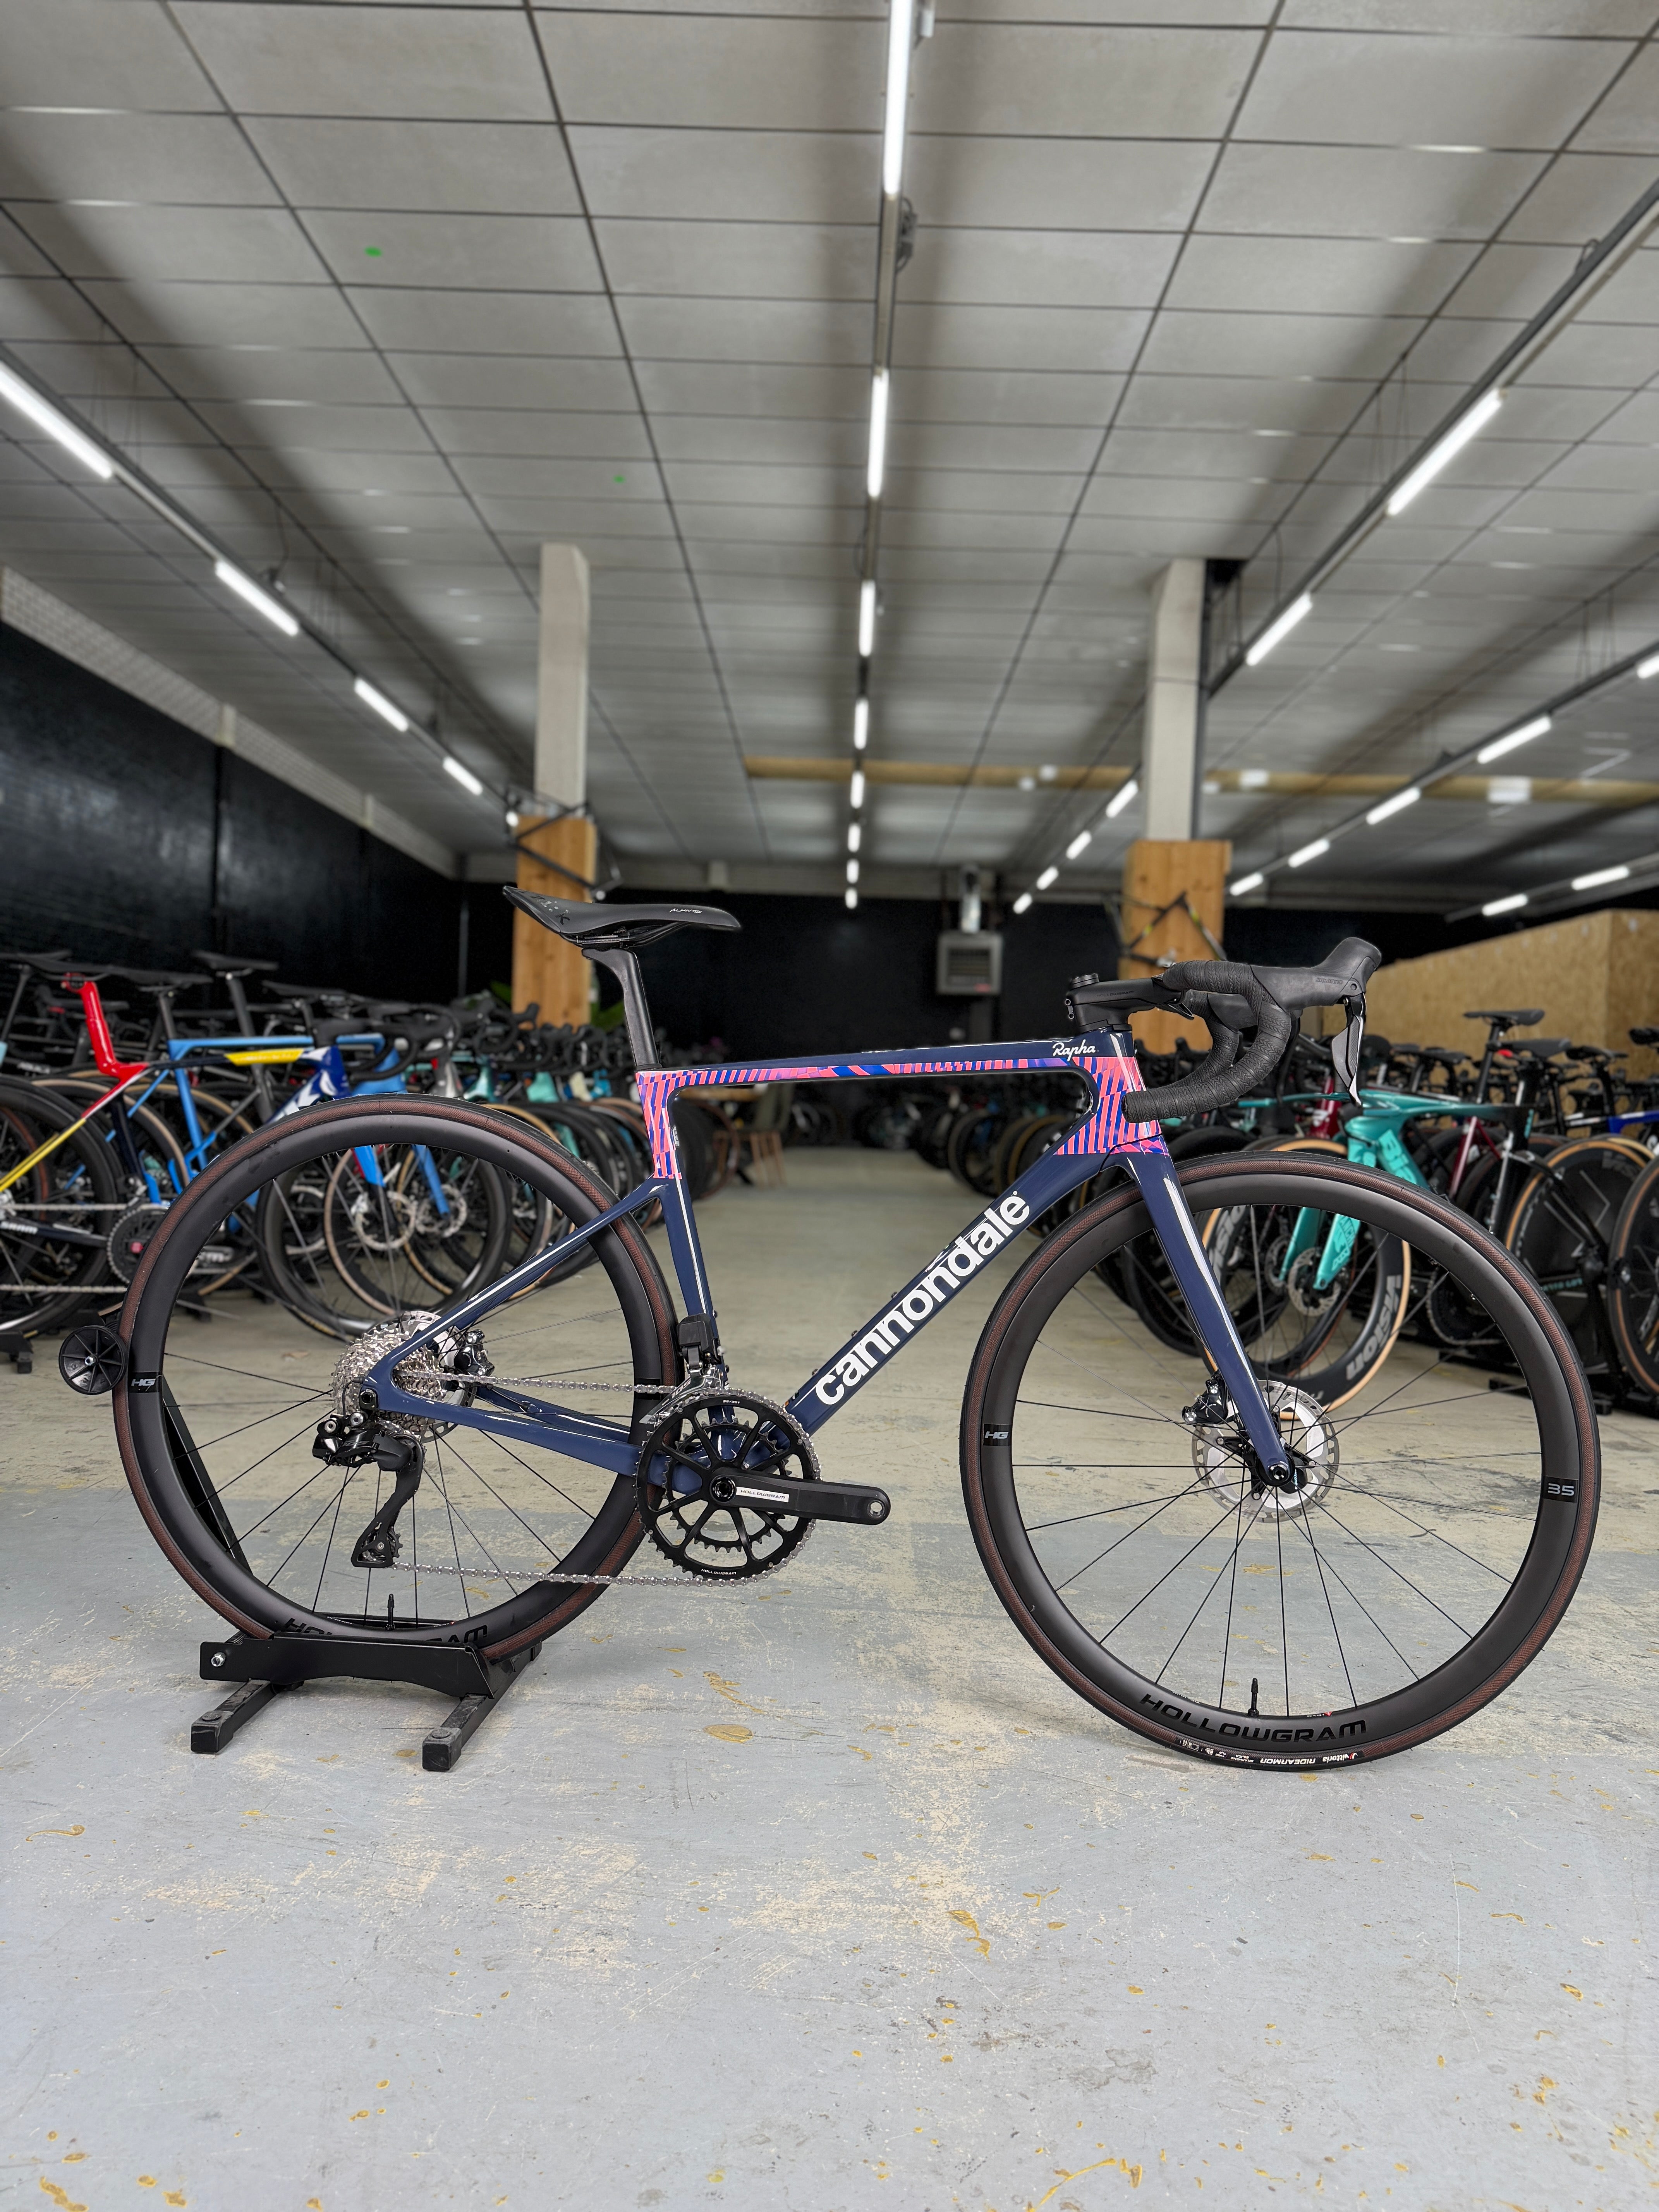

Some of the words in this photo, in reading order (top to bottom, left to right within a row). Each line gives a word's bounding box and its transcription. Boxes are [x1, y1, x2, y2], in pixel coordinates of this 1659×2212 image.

[1052, 1039, 1096, 1061] Rapha
[815, 1195, 1030, 1405] cannondale
[984, 1431, 1009, 1439] HG
[740, 1490, 785, 1499] HOLLOWGRAM
[1547, 1483, 1574, 1496] 35
[1139, 1693, 1366, 1743] HOLLOWGRAM
[1322, 1754, 1350, 1763] vittoria
